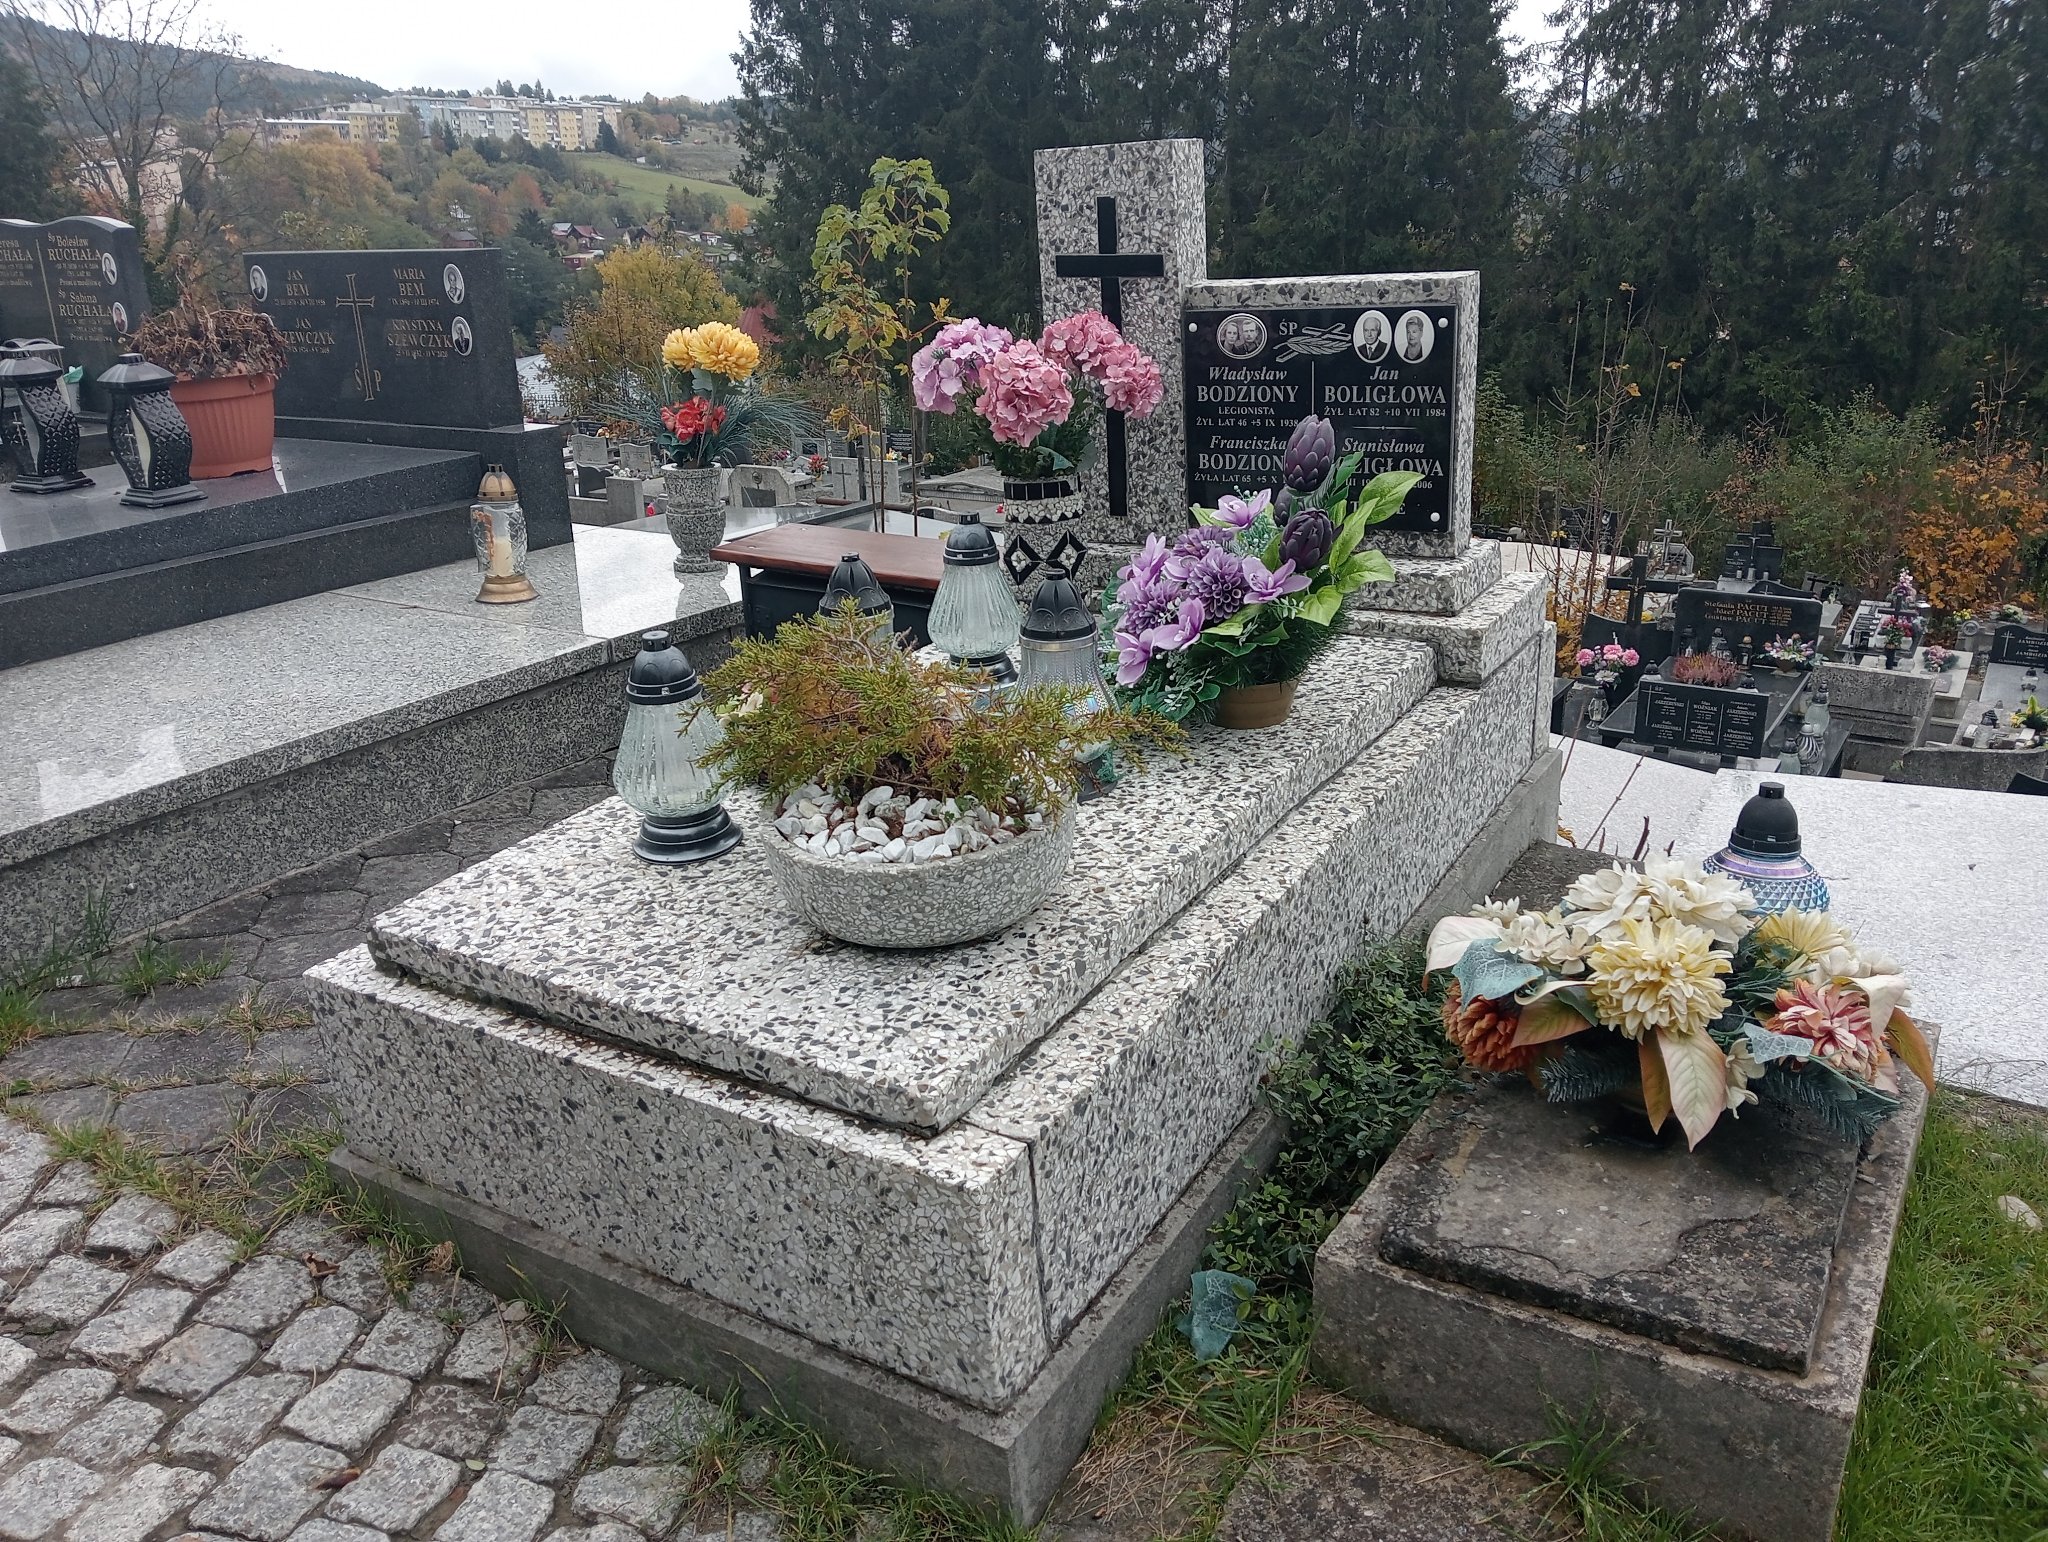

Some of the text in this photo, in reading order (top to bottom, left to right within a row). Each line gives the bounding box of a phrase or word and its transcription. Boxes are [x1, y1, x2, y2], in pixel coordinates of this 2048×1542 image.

[48, 248, 102, 261] RUCHAŁA
[288, 270, 303, 281] JAN
[393, 267, 425, 280] MARIA
[286, 283, 309, 296] BEM
[399, 282, 425, 296] BEM
[69, 291, 98, 303] Sabina
[295, 318, 312, 329] JAN
[392, 318, 443, 332] KRYSTYNA
[1279, 318, 1298, 336] ŚP
[279, 330, 335, 346] ZEWCZYK
[387, 333, 453, 348] SZEWCZYK
[1209, 366, 1287, 384] Władysław
[1369, 365, 1399, 380] Jan
[373, 369, 381, 391] P
[1196, 385, 1299, 403] BODZIONY
[1323, 385, 1447, 404] BOLIGŁOWA
[1218, 406, 1275, 415] LEGIONISTA
[1348, 407, 1368, 416] LAT
[1369, 408, 1380, 416] 82
[1384, 408, 1400, 417] +10
[1405, 408, 1420, 417] VII
[1426, 408, 1446, 417] 1984
[1218, 418, 1235, 426] LAT
[1237, 418, 1247, 427] 46
[1251, 418, 1261, 427] +5
[1265, 419, 1275, 427] IX
[1280, 419, 1299, 427] 1938
[1209, 435, 1287, 451] Franciszka
[1341, 437, 1425, 453] Stanisława
[1198, 453, 1284, 472] BODZION
[1194, 471, 1219, 482] ŻYŁA
[1222, 474, 1240, 482] LAT
[1241, 474, 1251, 483] 65
[1256, 475, 1267, 483] +5
[1271, 476, 1278, 484] X
[1413, 480, 1433, 489] 006
[1736, 609, 1767, 618] PACUT
